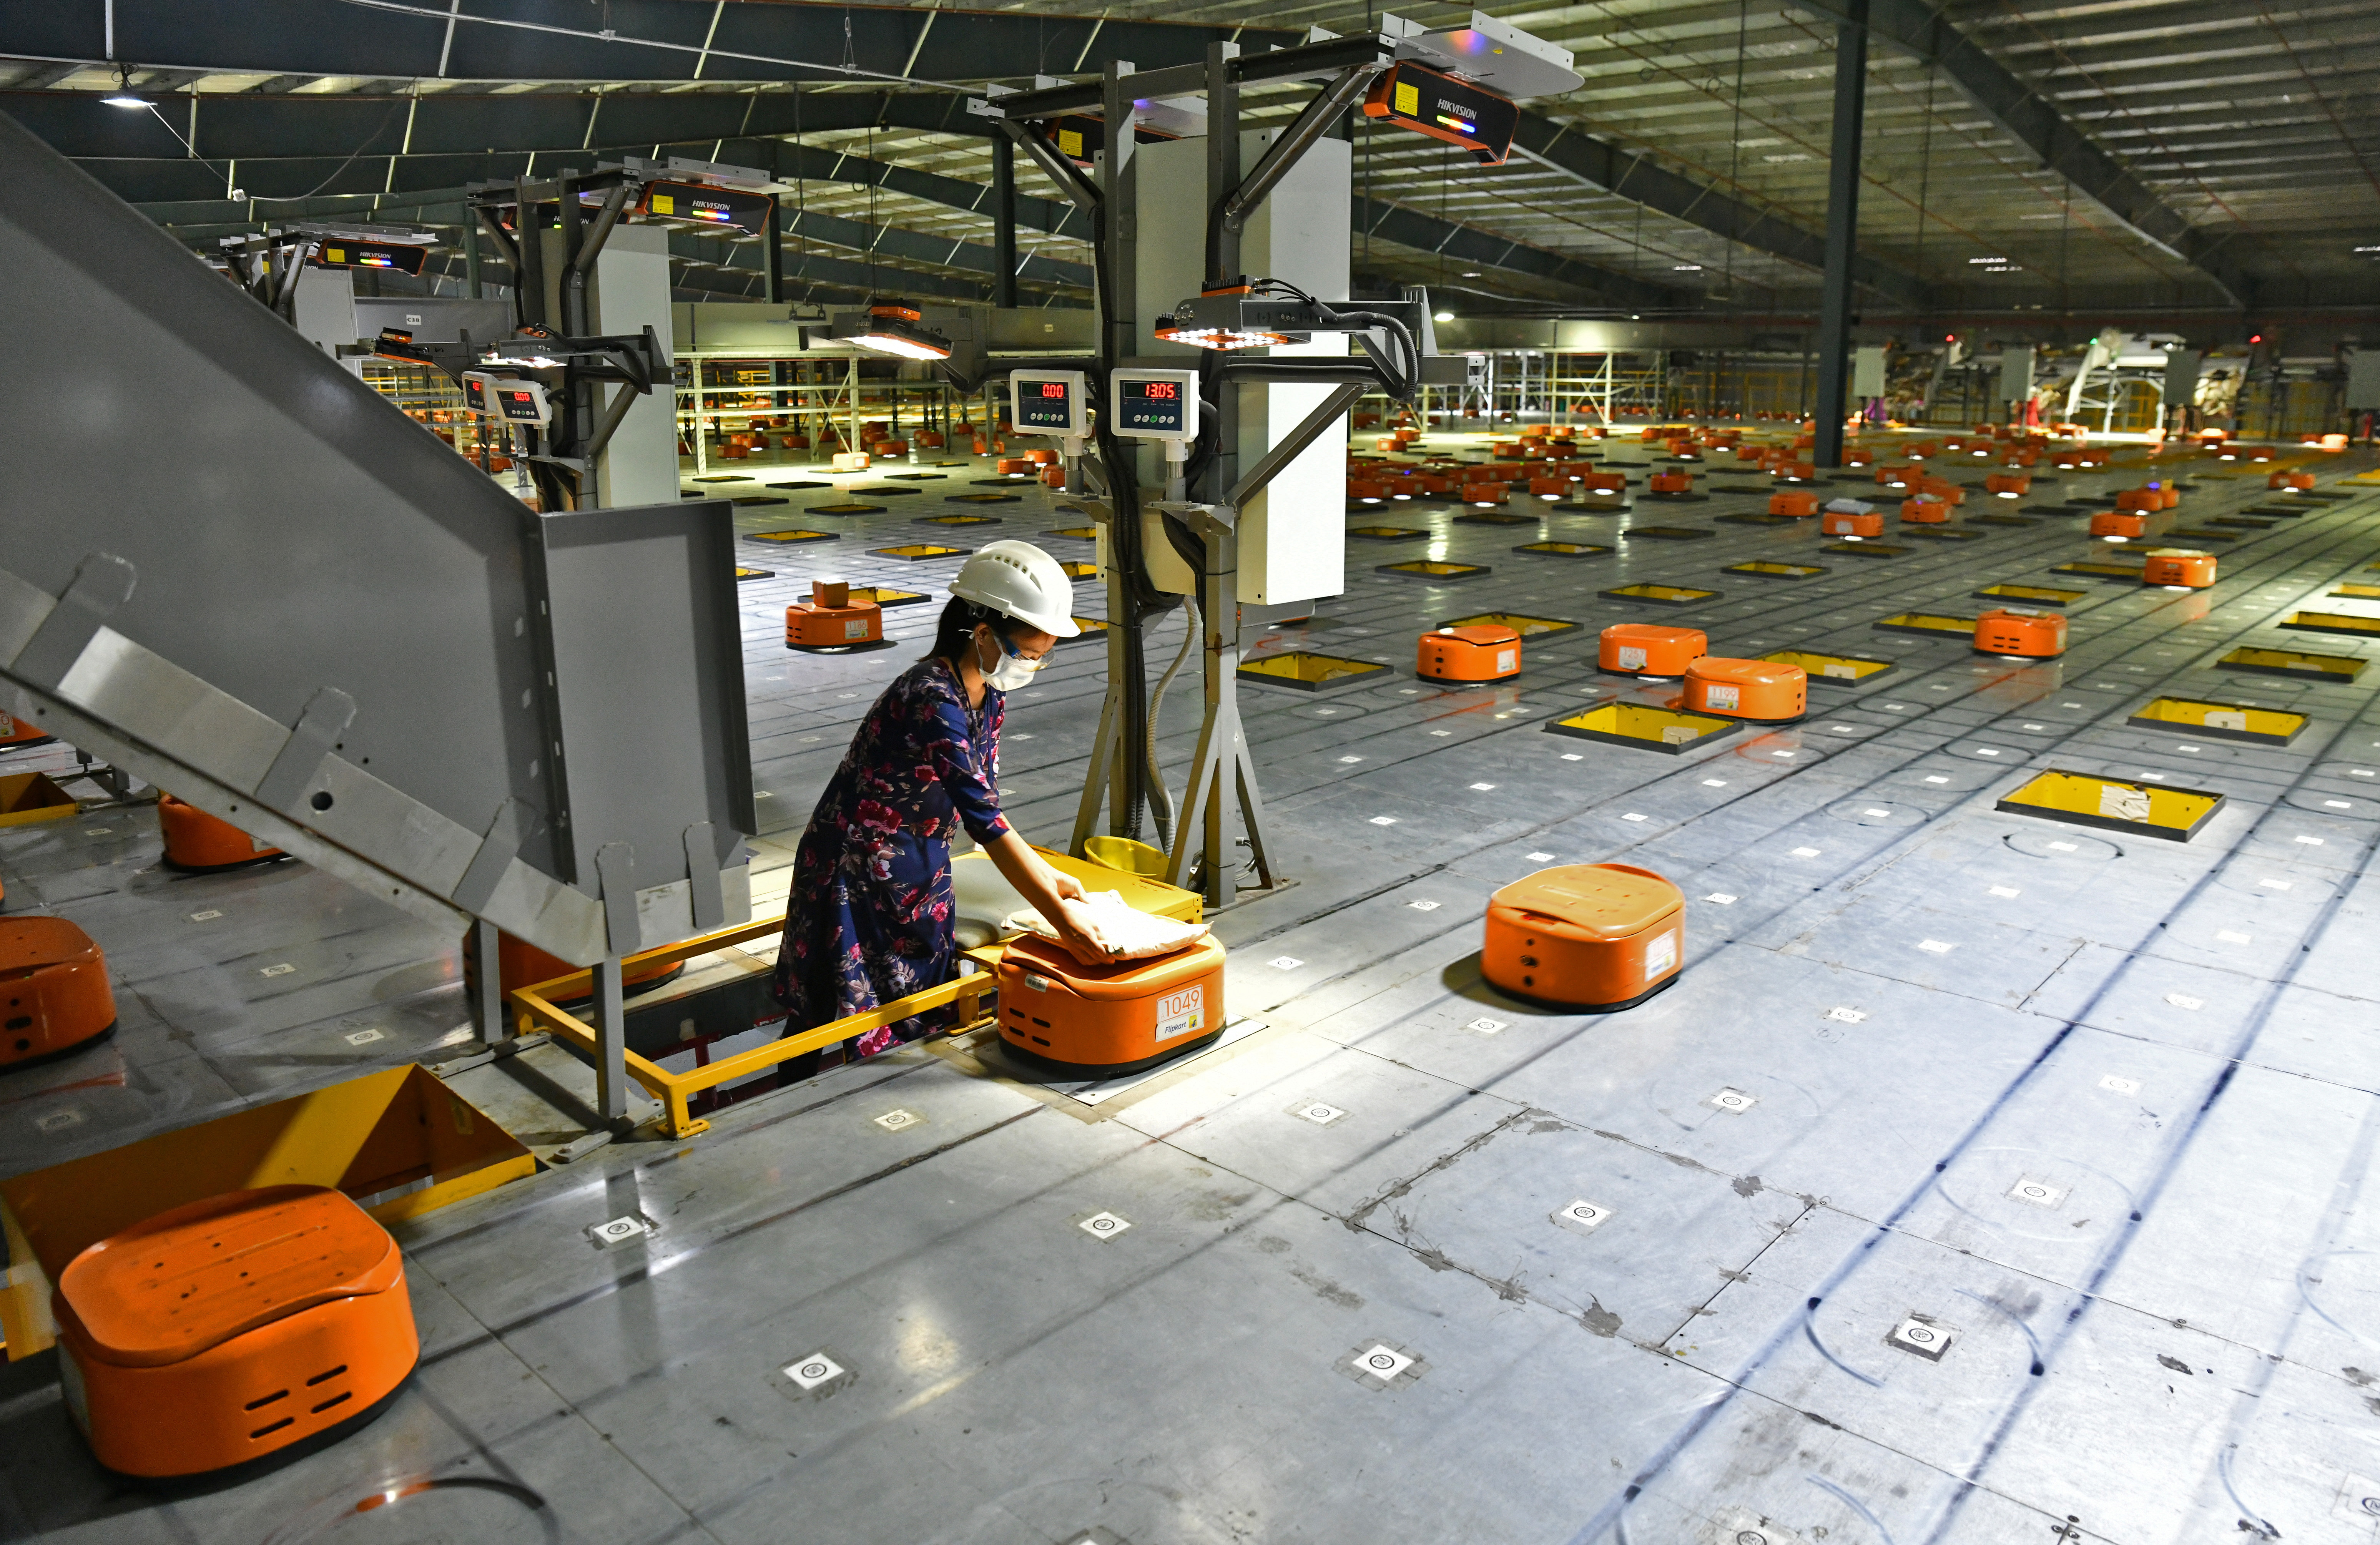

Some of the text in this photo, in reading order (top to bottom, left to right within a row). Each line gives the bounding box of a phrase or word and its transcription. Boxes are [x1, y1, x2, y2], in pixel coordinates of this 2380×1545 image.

[1437, 98, 1477, 120] HIKVISION
[692, 200, 730, 211] HIKVISION
[1042, 384, 1064, 398] 0.00
[1145, 384, 1175, 399] 13.05
[849, 621, 866, 630] 1186
[1713, 687, 1737, 699] 1199
[1165, 990, 1200, 1017] 1049
[1165, 1021, 1187, 1034] Flipkart
